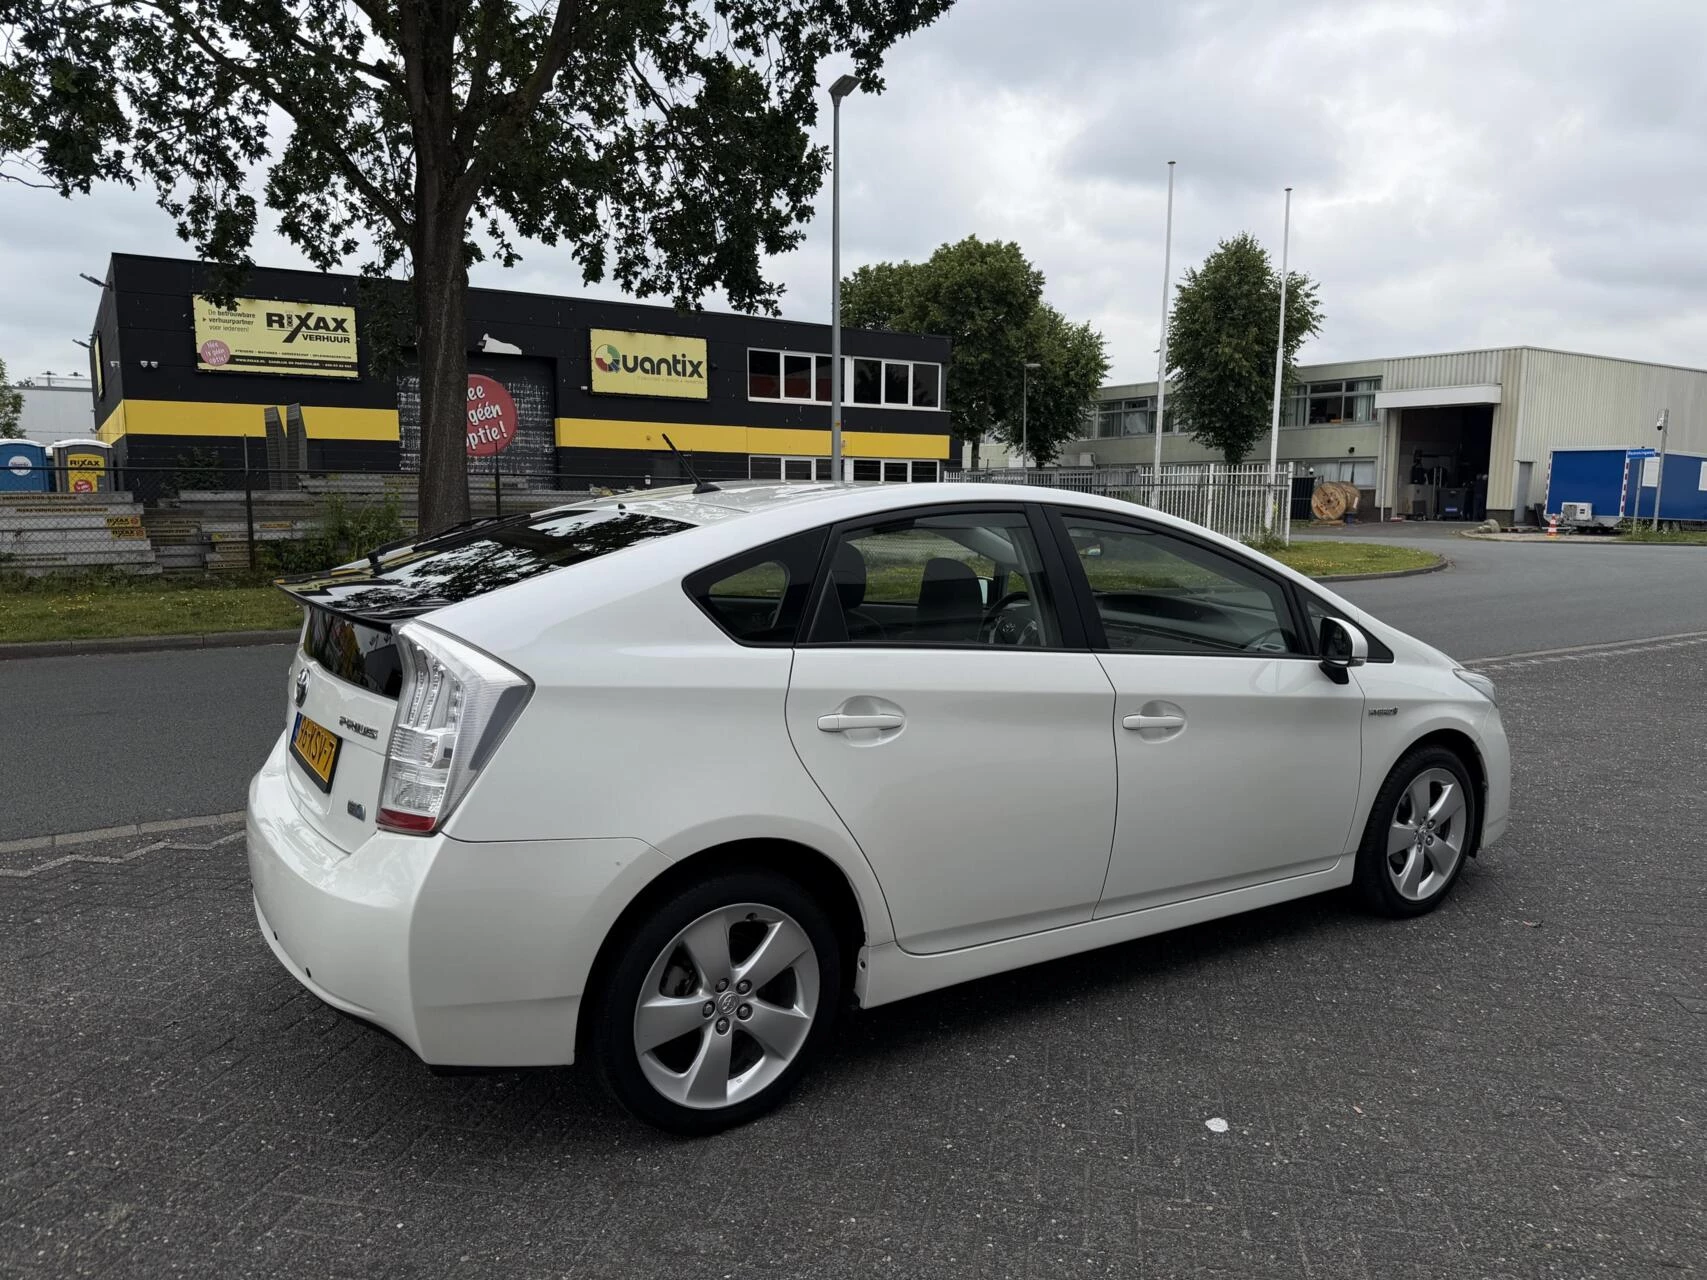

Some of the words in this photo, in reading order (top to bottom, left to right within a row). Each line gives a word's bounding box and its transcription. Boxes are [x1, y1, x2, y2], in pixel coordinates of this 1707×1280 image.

[217, 309, 256, 319] betrouwbare
[208, 318, 254, 326] verhuurpartner
[302, 333, 351, 344] VERHUUR
[594, 343, 704, 379] Quantix
[468, 401, 503, 426] géén
